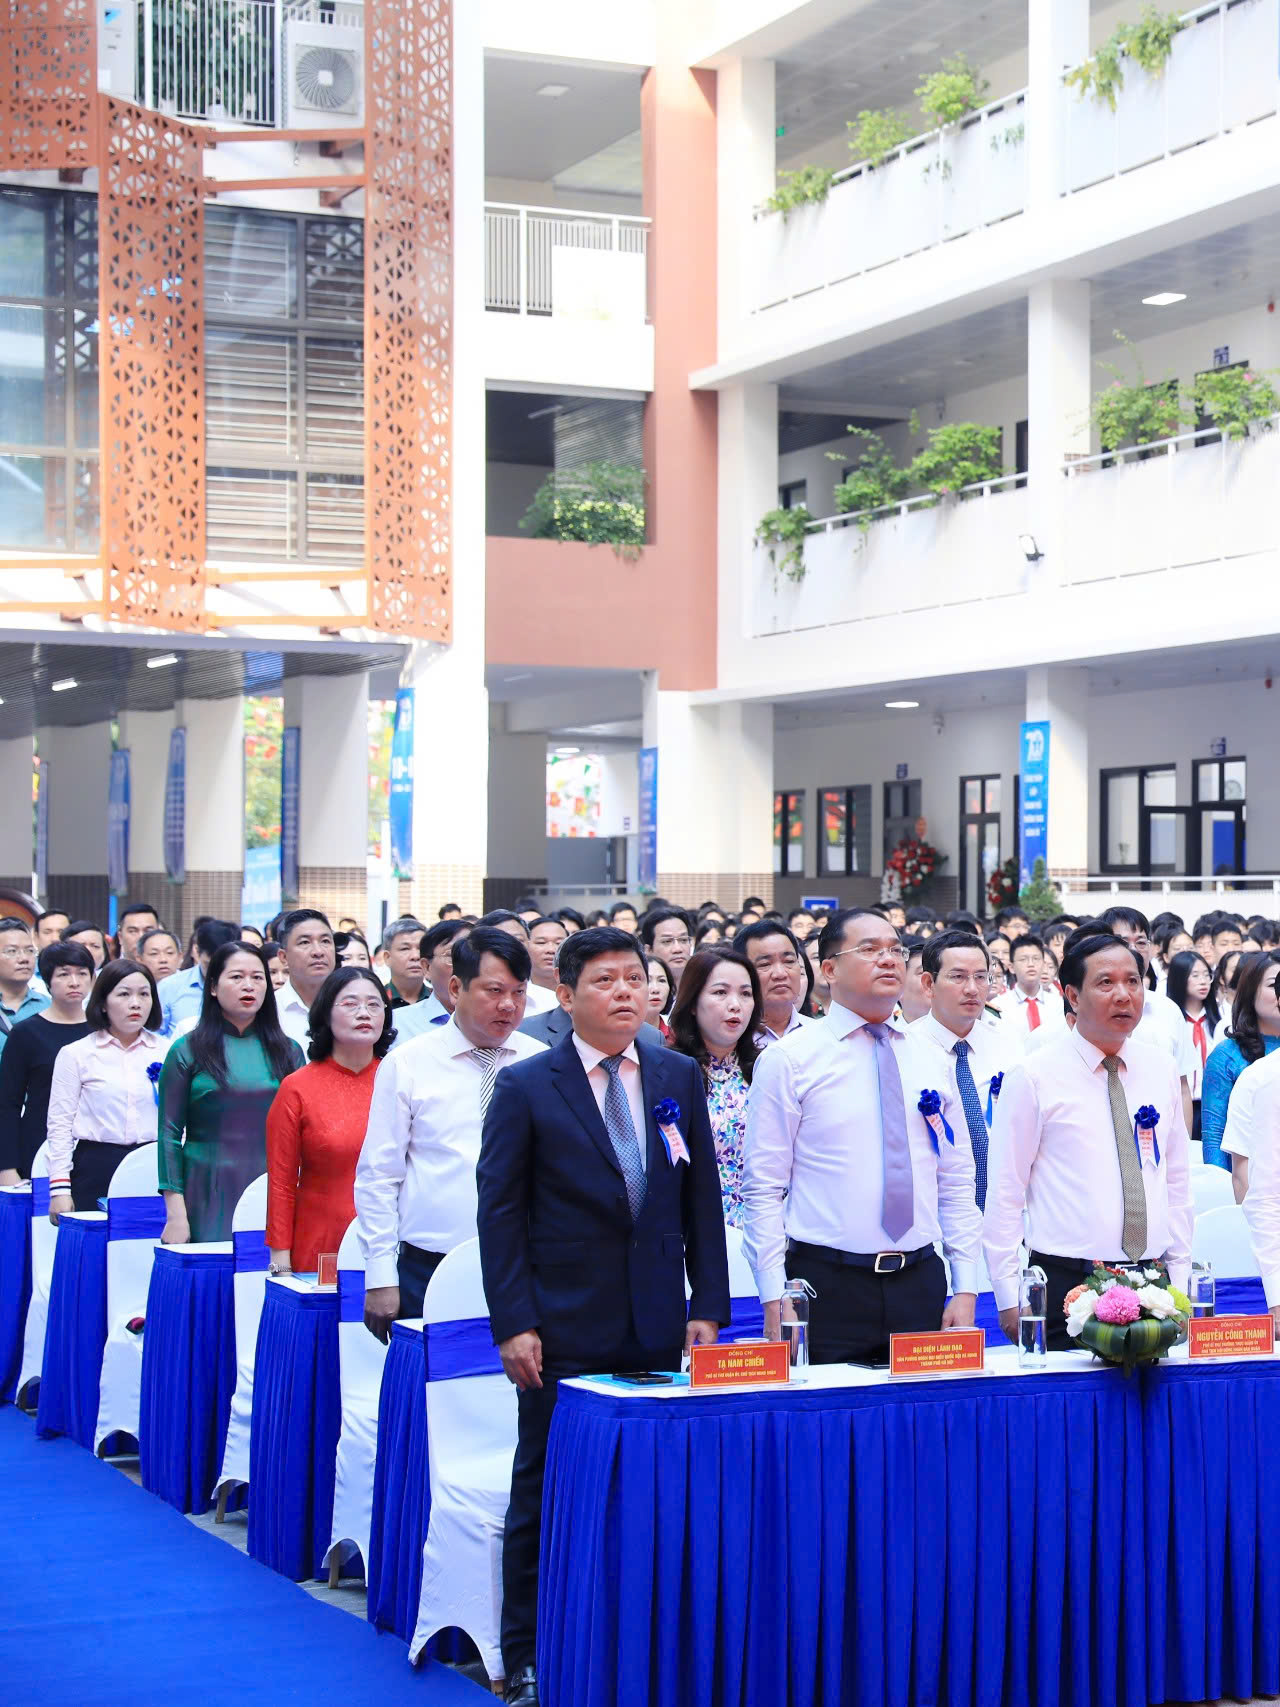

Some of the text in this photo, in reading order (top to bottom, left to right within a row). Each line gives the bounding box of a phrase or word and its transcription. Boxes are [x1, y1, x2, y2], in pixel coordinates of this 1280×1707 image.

[1196, 1328, 1267, 1341] NGUYỄN CÔNG THÀNH
[718, 1355, 765, 1370] TẠ NAM CHIẾN
